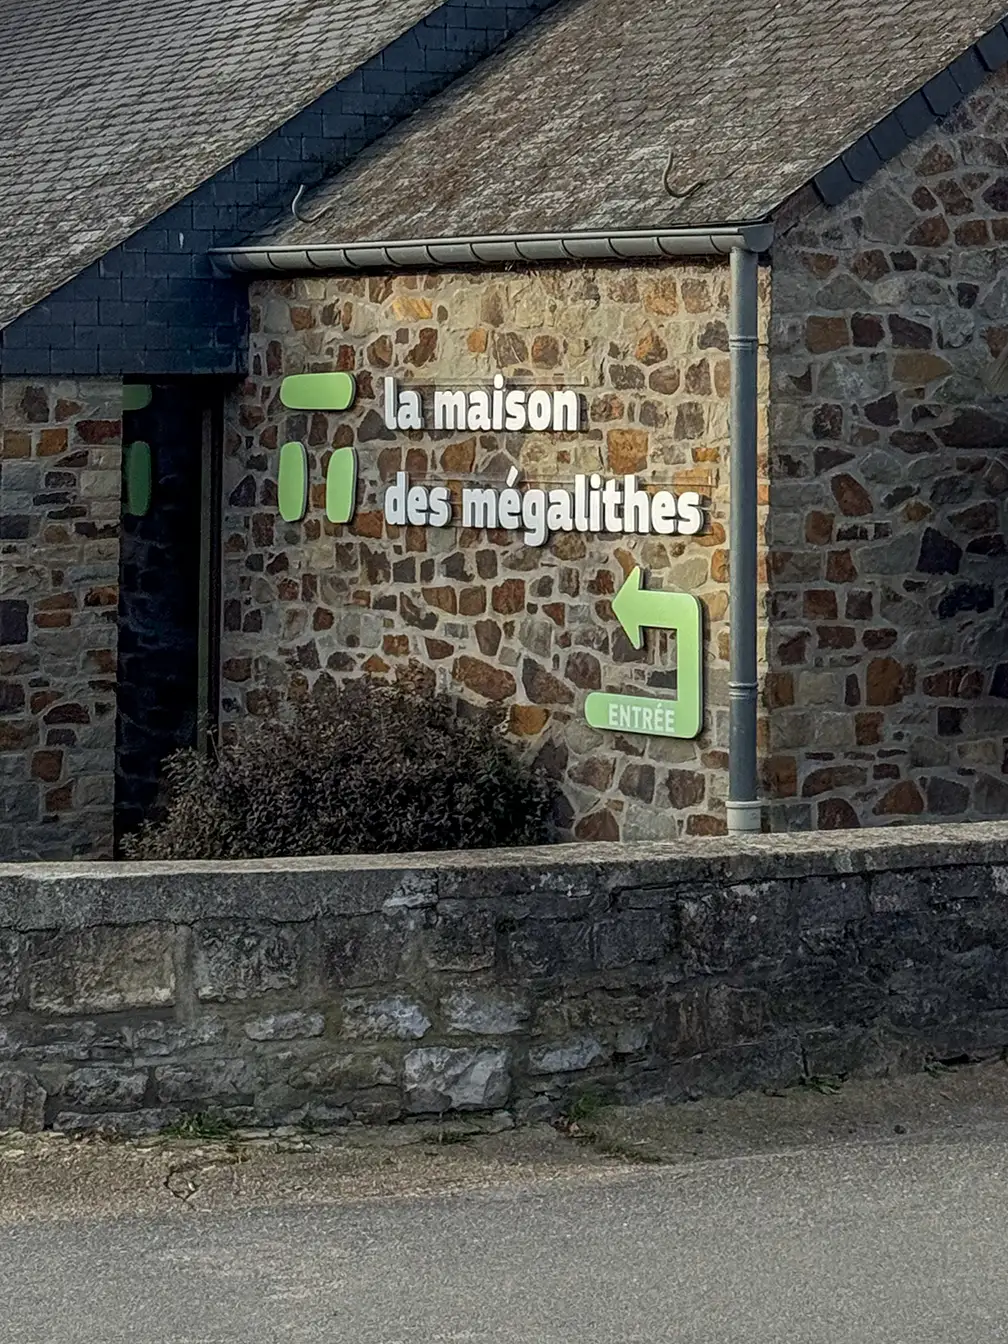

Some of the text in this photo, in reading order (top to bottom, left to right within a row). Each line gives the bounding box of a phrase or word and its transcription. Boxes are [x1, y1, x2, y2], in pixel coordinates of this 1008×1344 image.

[384, 373, 580, 431] la maison
[384, 465, 704, 546] des mégalithes
[607, 700, 676, 733] ENTRÉE
